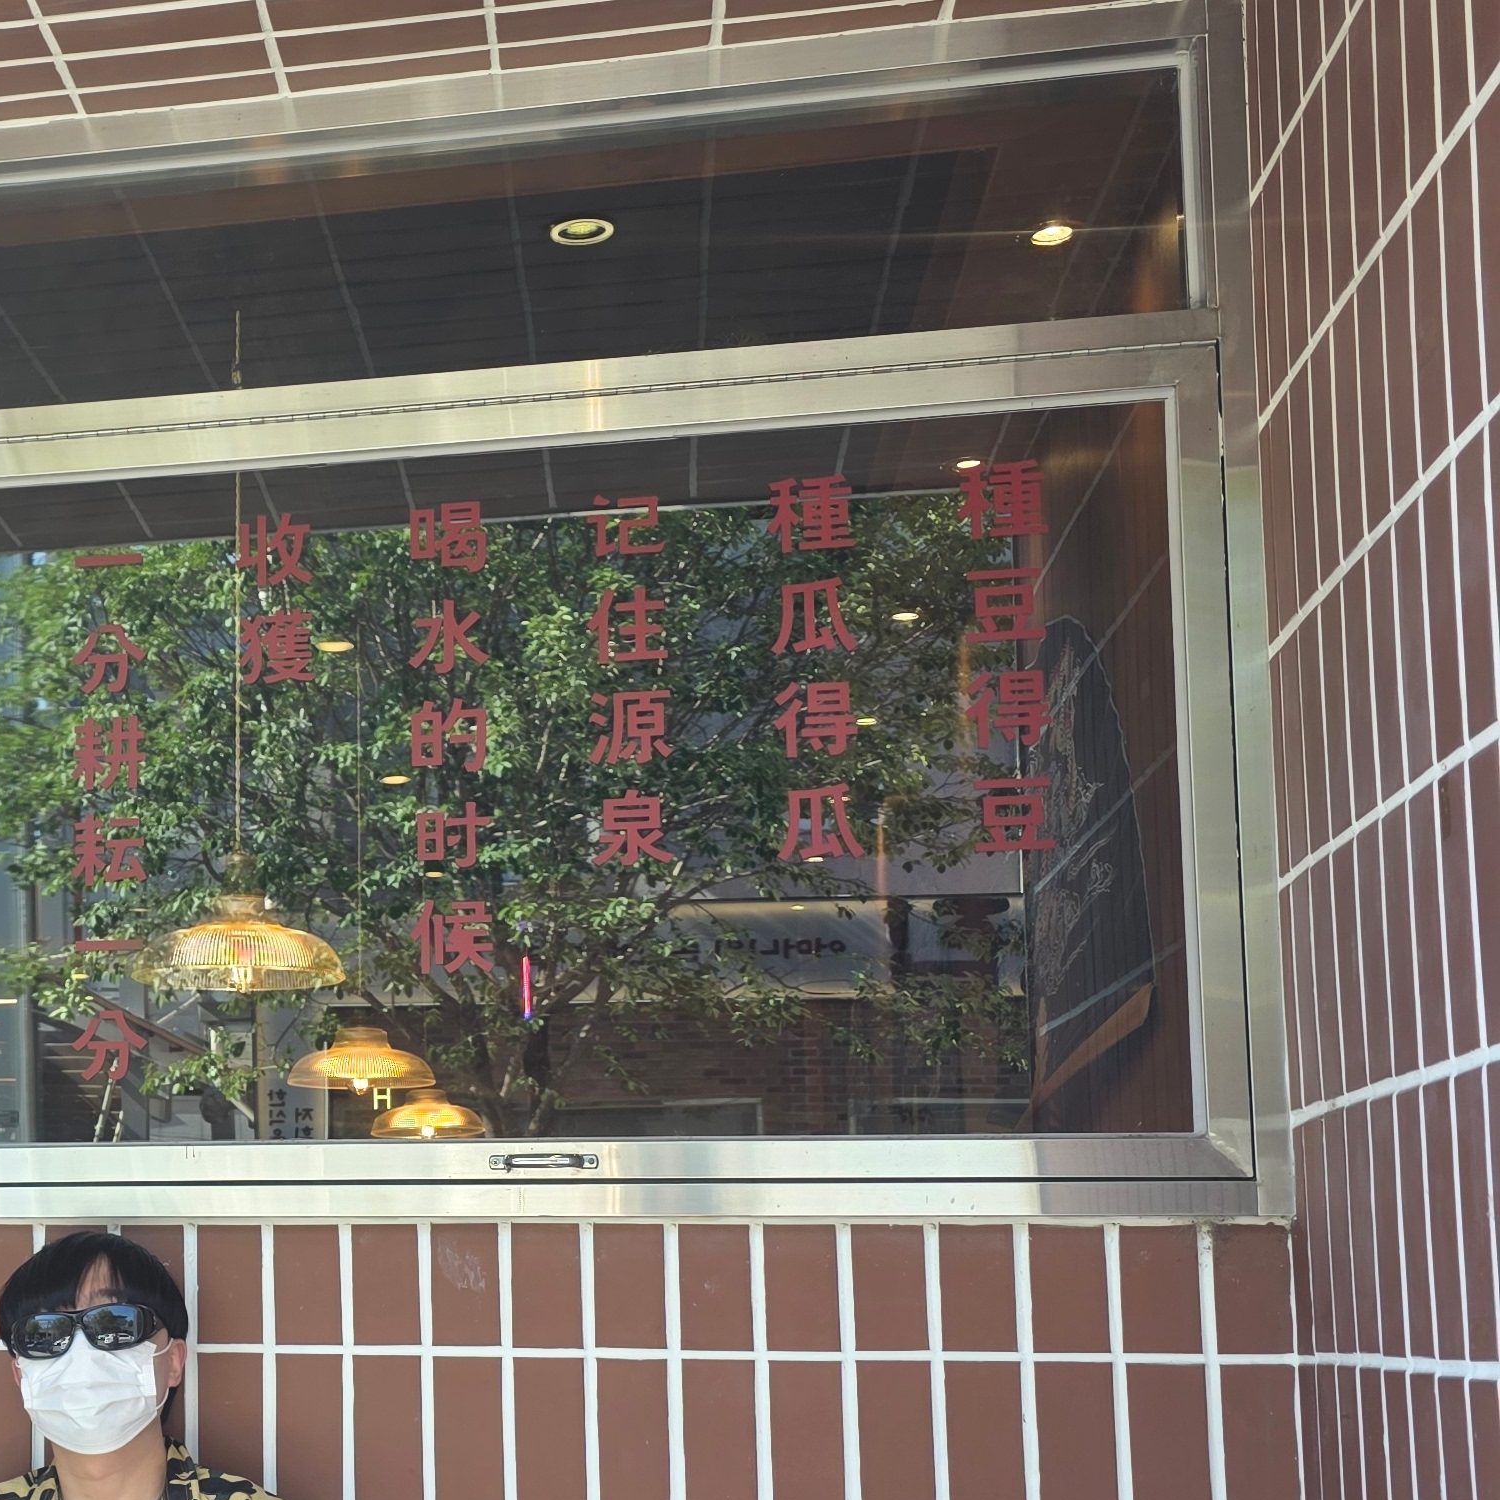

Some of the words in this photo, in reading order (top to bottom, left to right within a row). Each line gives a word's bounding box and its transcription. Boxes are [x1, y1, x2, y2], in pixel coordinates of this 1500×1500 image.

[238, 513, 315, 686] 收獲
[409, 501, 495, 975] 喝水的时候
[587, 494, 675, 866] 记住源泉
[767, 474, 865, 862] 種瓜得瓜
[957, 459, 1055, 853] 種豆得豆
[71, 553, 147, 1081] 一分耕耘一分
